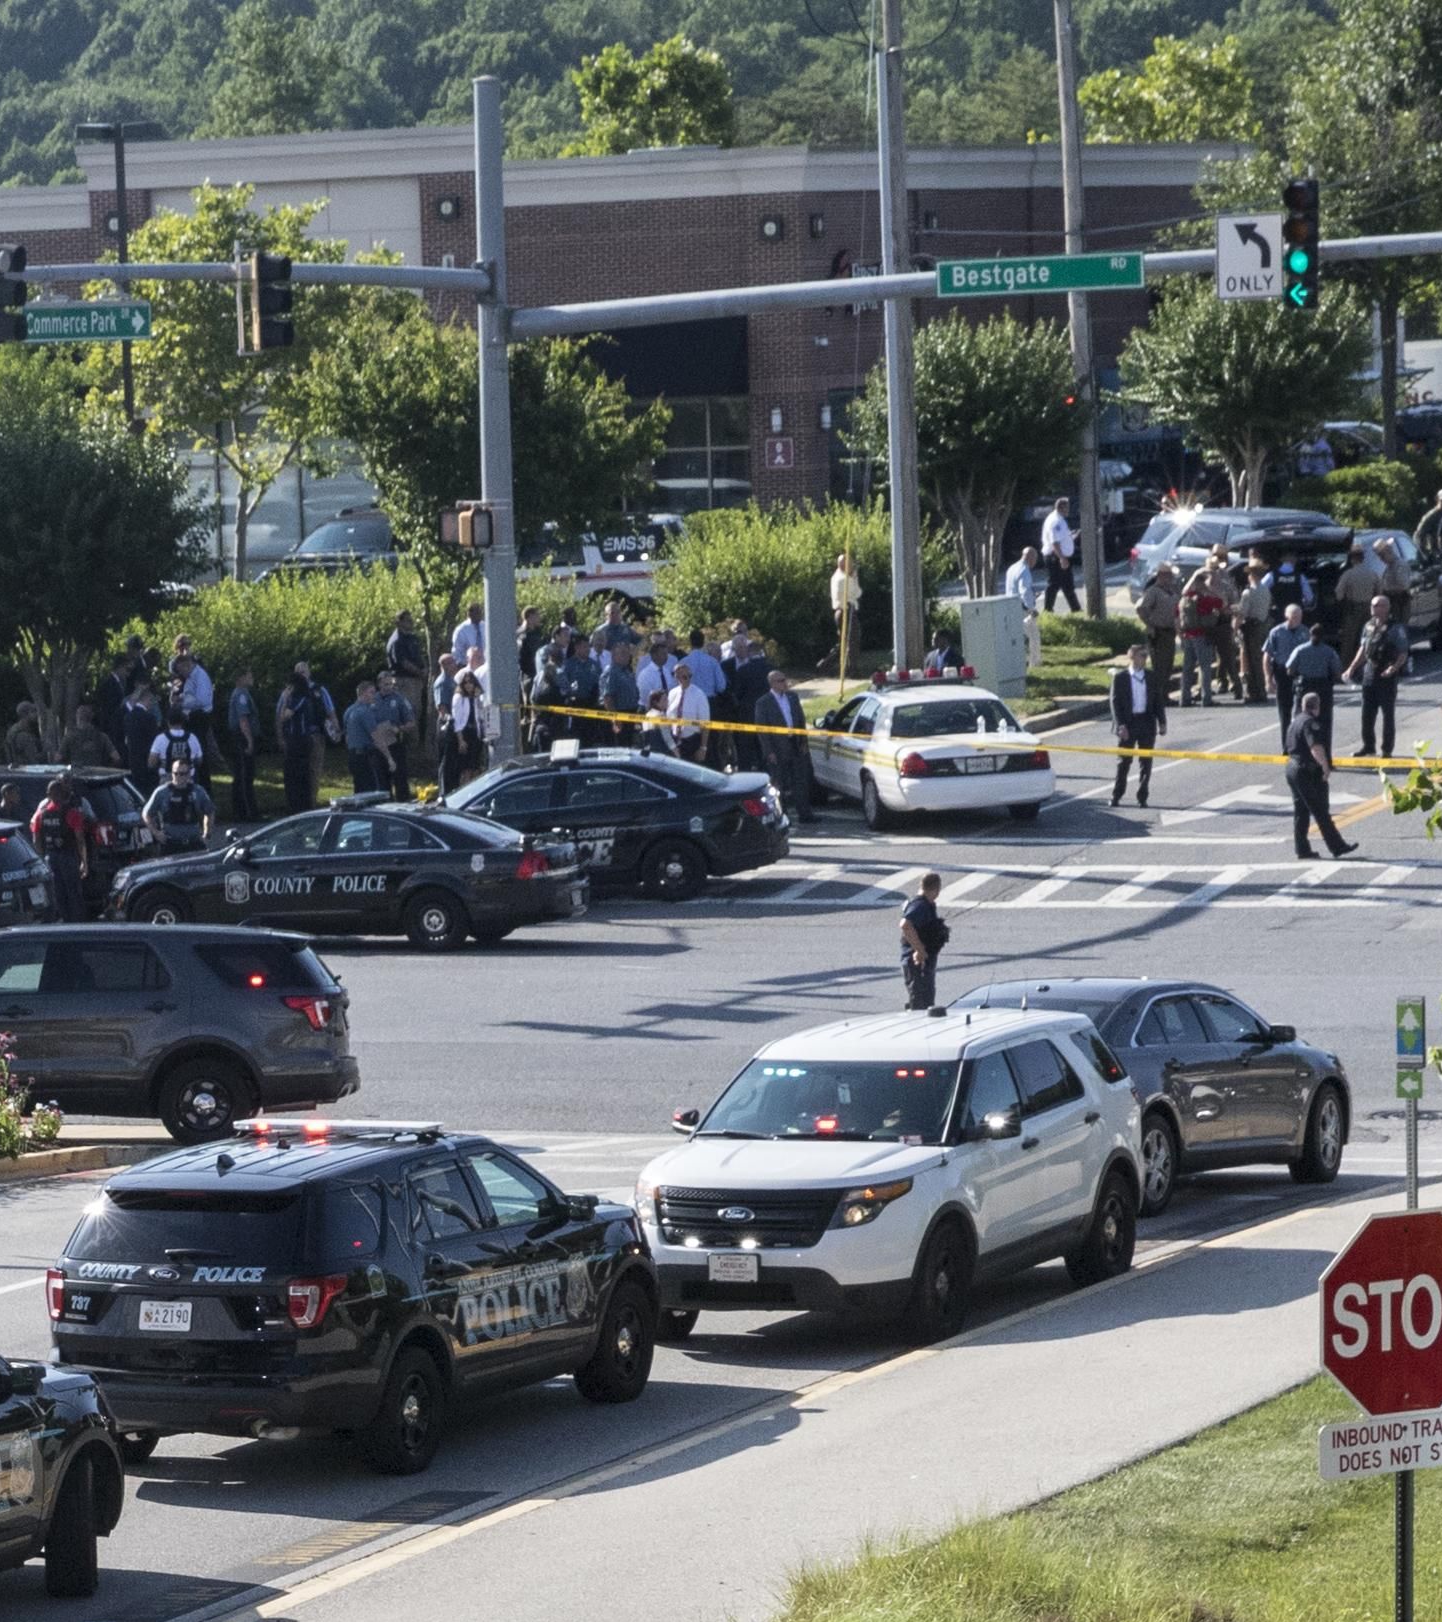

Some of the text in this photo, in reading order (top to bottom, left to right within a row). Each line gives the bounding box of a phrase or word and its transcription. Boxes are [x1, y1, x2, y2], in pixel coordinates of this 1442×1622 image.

[952, 257, 1127, 290] Bestgate RD
[1226, 275, 1274, 292] ONLY
[27, 312, 87, 335] Commerce
[91, 311, 116, 332] Park
[577, 826, 618, 838] COUNTY
[254, 875, 388, 895] COUNTY POLICE
[79, 1262, 142, 1281] COUNTY
[192, 1267, 266, 1283] POLICE
[526, 1260, 558, 1279] COUNTY
[459, 1278, 566, 1345] POLICE
[1332, 1422, 1403, 1448] INBOUND
[1339, 1450, 1382, 1473] DOES
[1390, 1445, 1422, 1465] NOT
